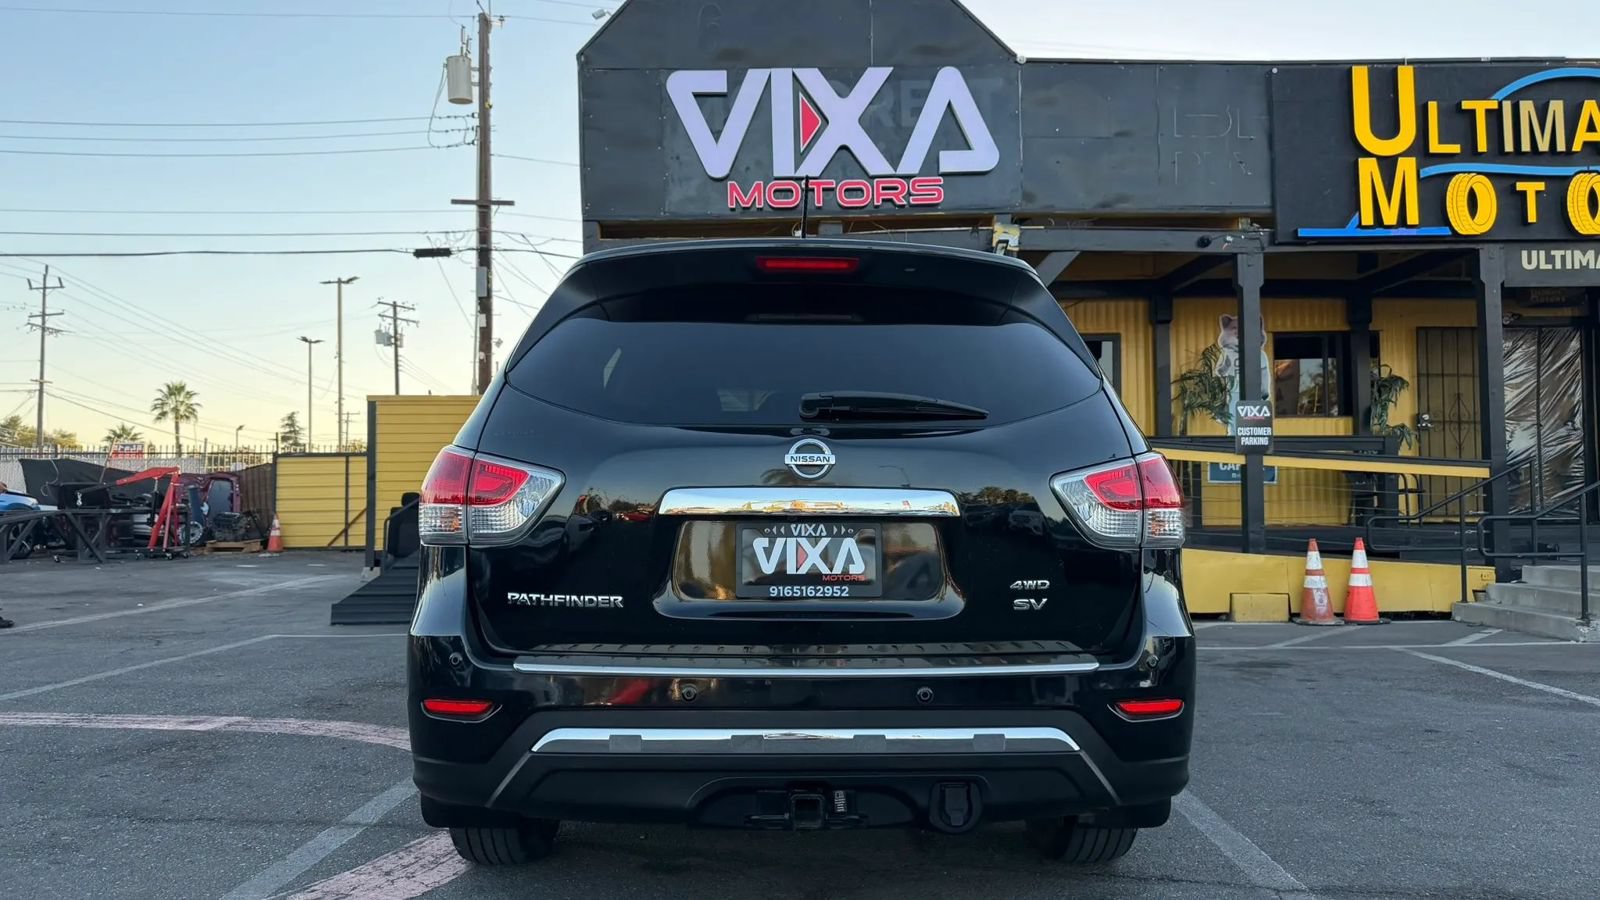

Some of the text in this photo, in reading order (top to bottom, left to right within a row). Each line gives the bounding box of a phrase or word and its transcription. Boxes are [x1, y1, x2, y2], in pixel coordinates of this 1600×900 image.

[1352, 65, 1600, 156] ULTIMA
[666, 66, 1000, 179] VIXA
[727, 176, 944, 208] MOTORS
[1521, 249, 1600, 270] ULTIM
[1237, 405, 1271, 417] VIXA
[1237, 426, 1272, 436] CUSTOMER
[1241, 436, 1269, 446] PARKING
[790, 455, 831, 463] NISSAN
[790, 523, 827, 537] VIXA
[752, 537, 866, 575] VIXA
[822, 574, 866, 582] MOTORS
[769, 585, 849, 597] 9165162952
[1010, 580, 1050, 590] 4WD
[507, 592, 624, 608] PATHFINDER
[1013, 598, 1048, 610] SV
